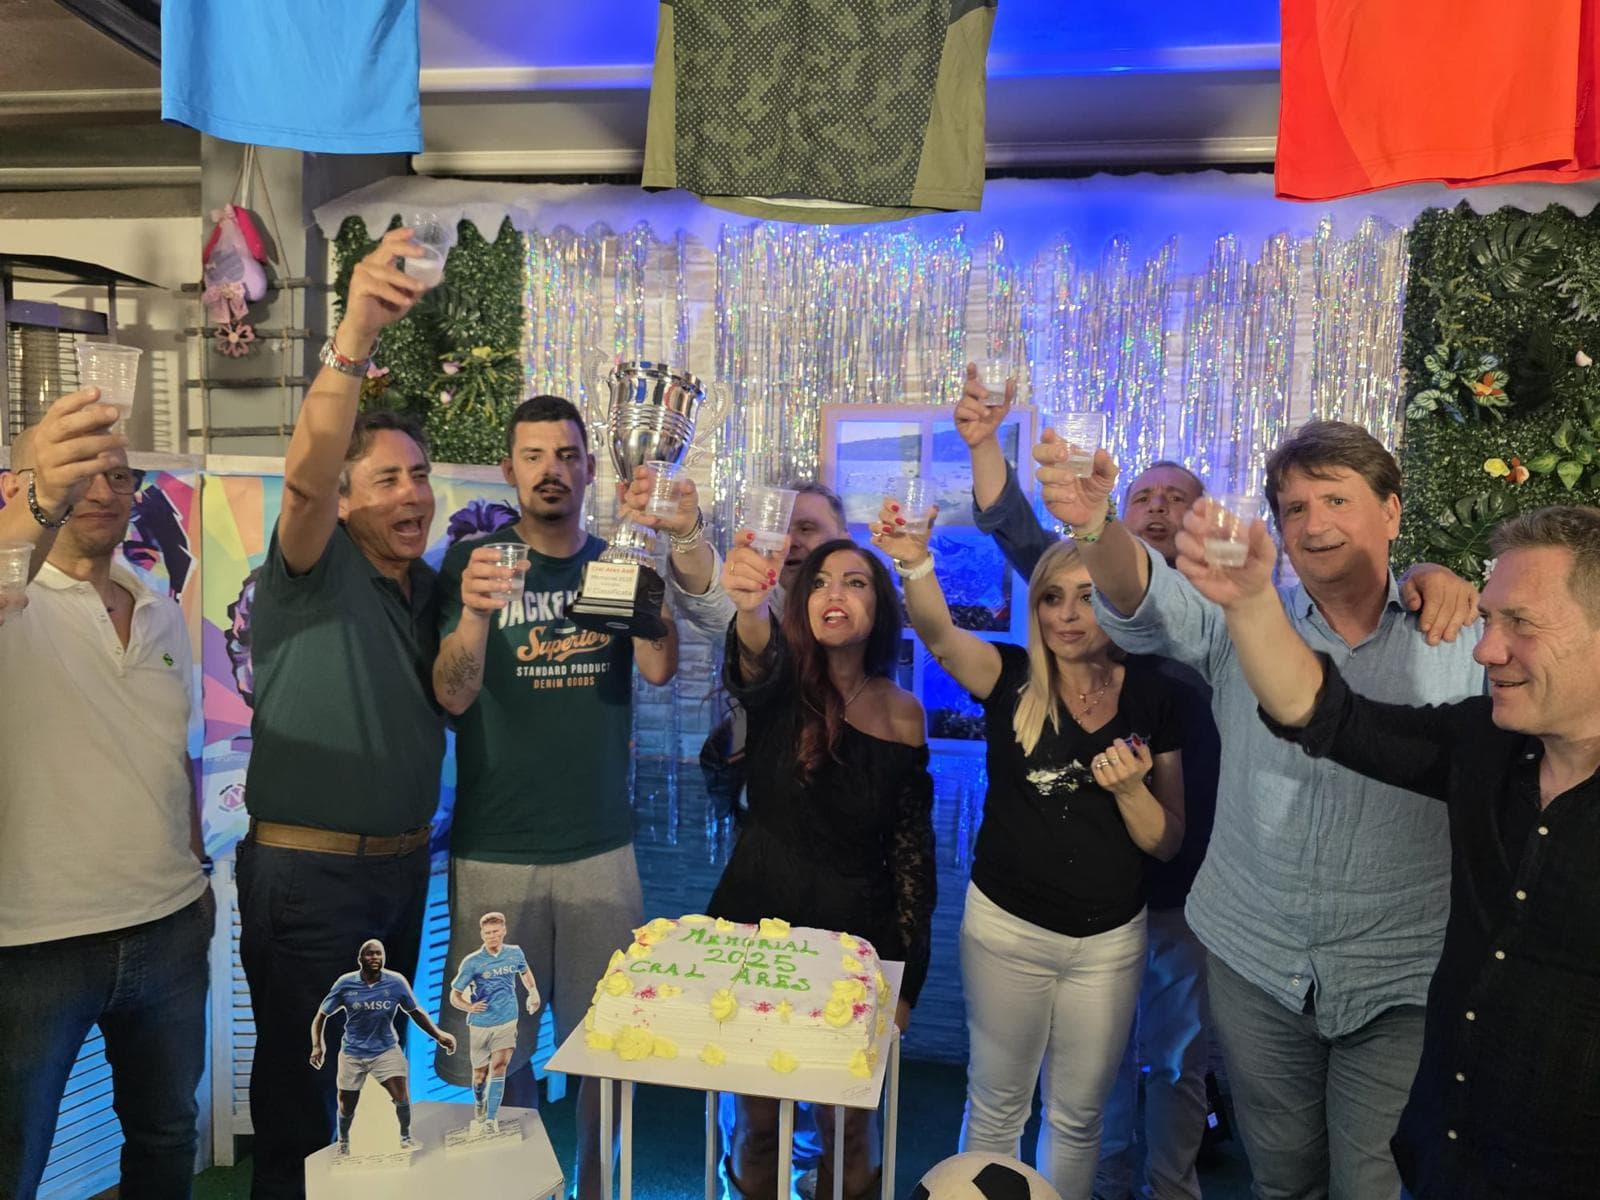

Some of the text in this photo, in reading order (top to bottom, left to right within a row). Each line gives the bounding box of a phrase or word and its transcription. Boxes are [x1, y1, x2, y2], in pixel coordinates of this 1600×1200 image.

[516, 626, 609, 662] Superior
[516, 664, 567, 677] STANDARD
[533, 676, 595, 689] DENIM GOODS
[703, 948, 797, 973] 2025
[492, 964, 516, 977] MSC
[730, 968, 811, 992] ARES
[363, 1000, 392, 1010] MSC
